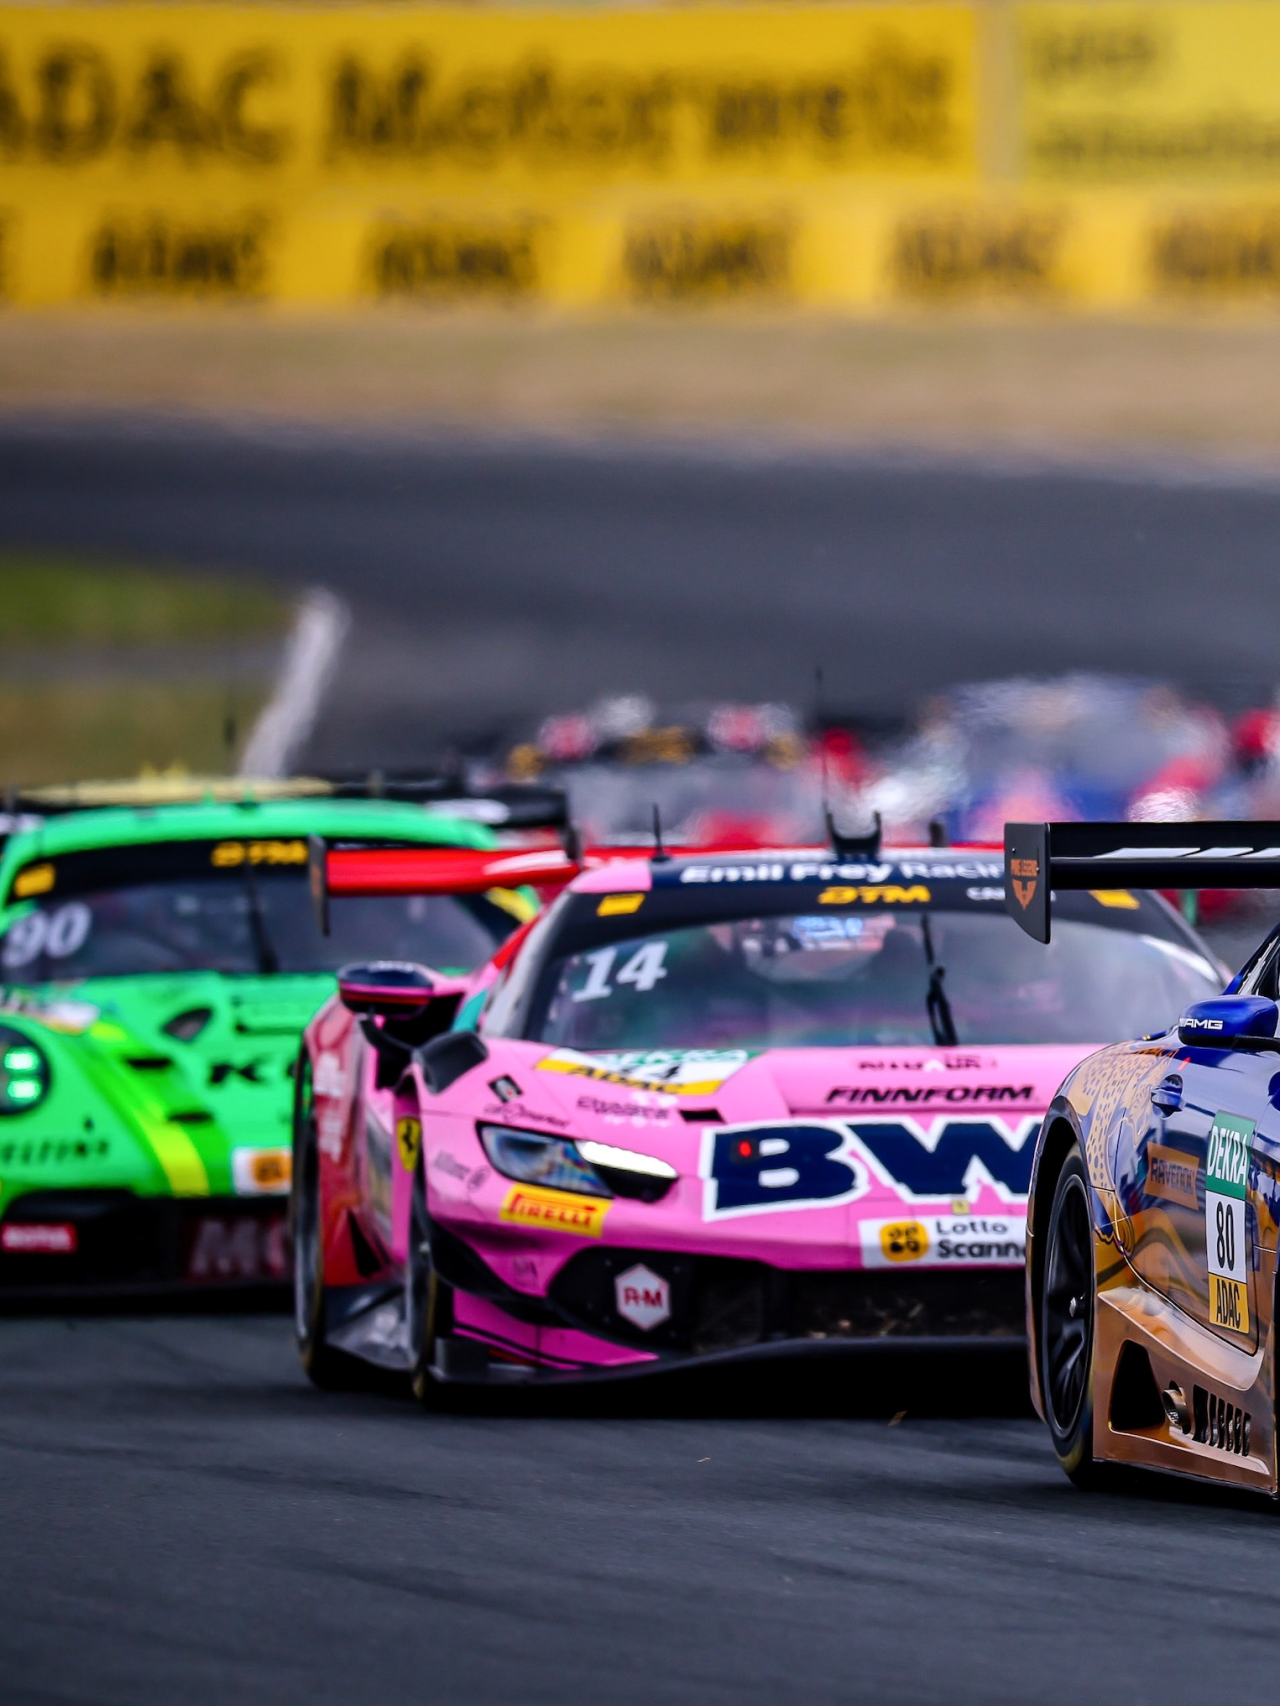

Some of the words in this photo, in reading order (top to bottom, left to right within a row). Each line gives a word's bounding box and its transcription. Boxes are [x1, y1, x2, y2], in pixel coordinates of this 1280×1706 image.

[680, 863, 784, 883] Emil
[790, 863, 894, 883] Frey
[817, 885, 932, 905] DTM
[2, 902, 92, 968] 90
[572, 940, 669, 1002] 14
[1181, 1017, 1224, 1031] AMG
[825, 1084, 1035, 1104] FINNFORM
[700, 1116, 1035, 1221] BW
[1206, 1125, 1248, 1186] DEKRA
[1150, 1156, 1196, 1196] RAVENOL
[508, 1192, 598, 1229] PIRELLI
[935, 1220, 1009, 1235] Lotto
[937, 1238, 1027, 1259] Scann
[1216, 1200, 1235, 1272] 80
[1216, 1278, 1241, 1330] ADAC
